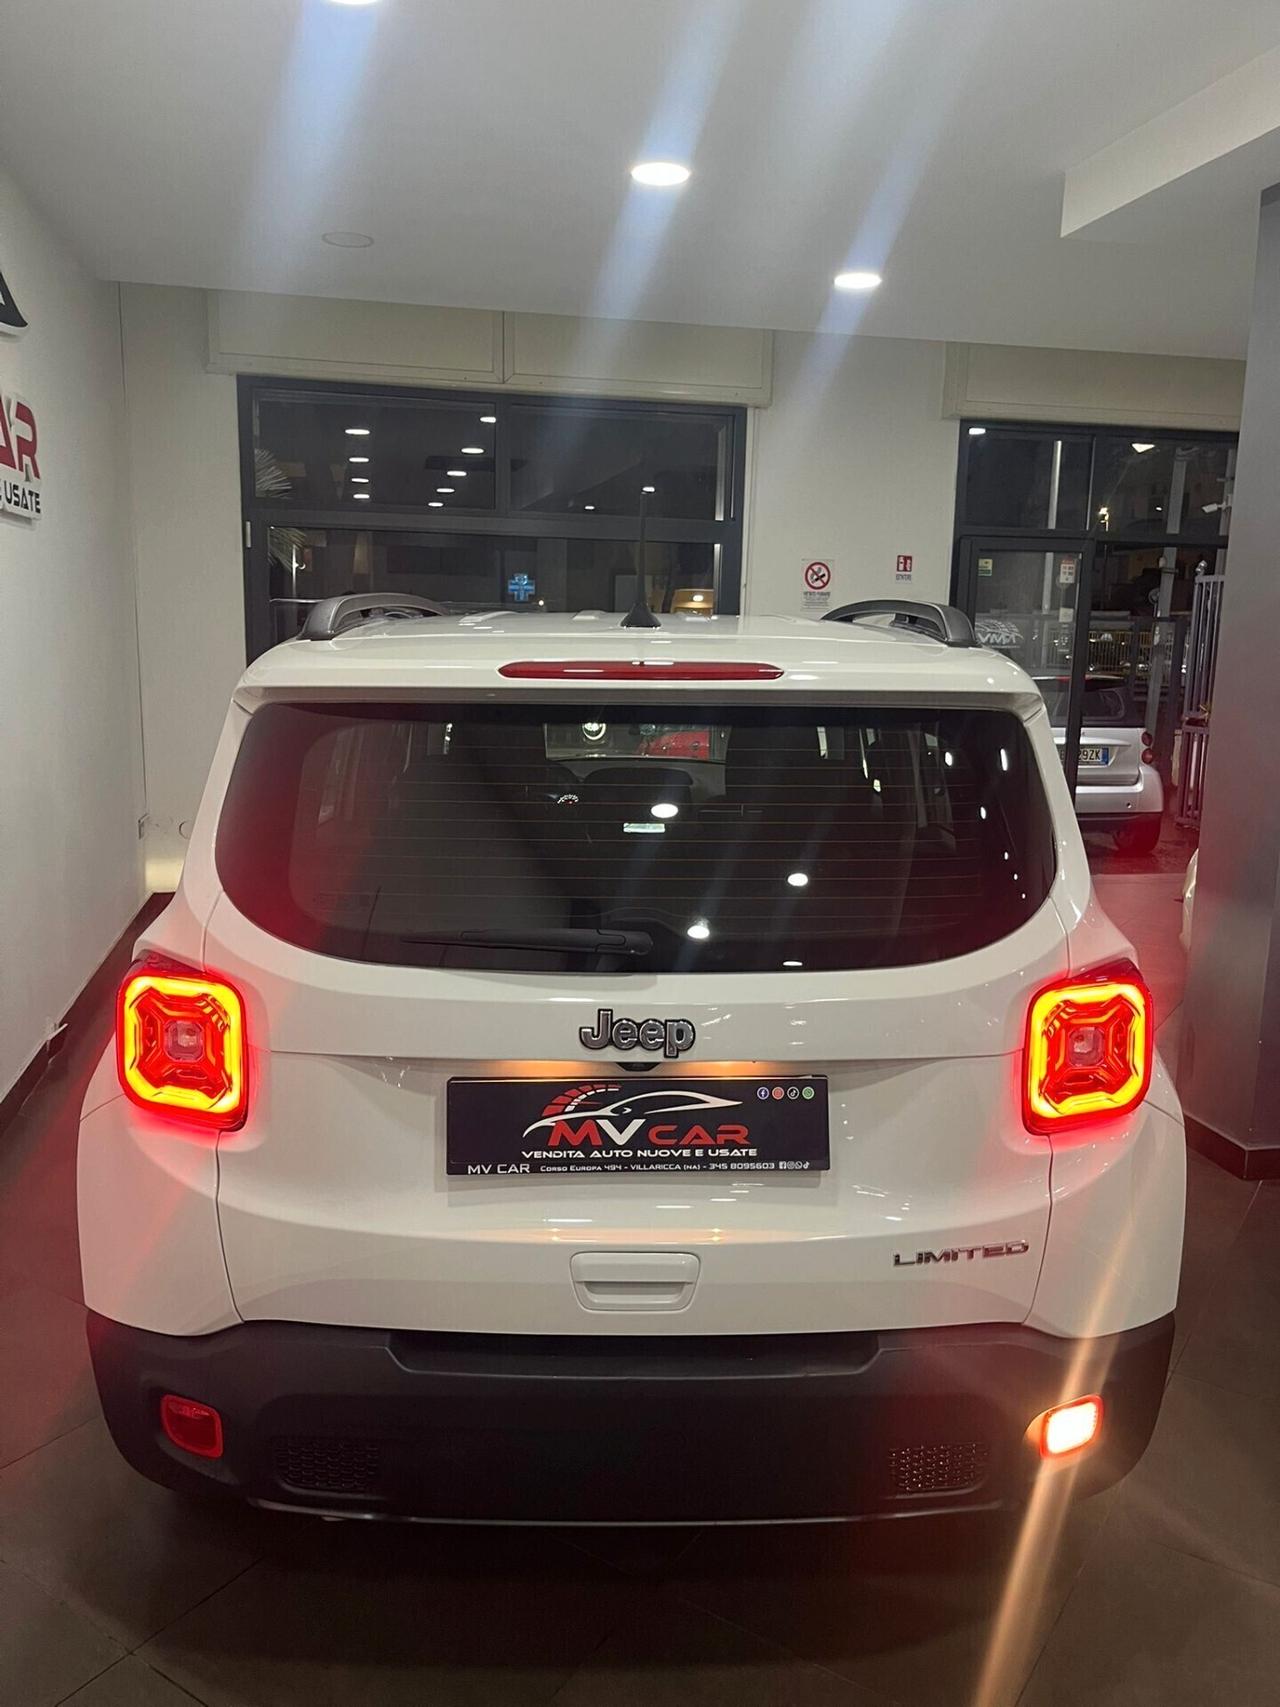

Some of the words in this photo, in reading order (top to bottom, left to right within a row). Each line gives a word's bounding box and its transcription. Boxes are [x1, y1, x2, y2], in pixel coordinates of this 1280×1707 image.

[3, 480, 41, 514] USATE
[579, 1008, 696, 1058] Jeep
[547, 1118, 646, 1147] MV
[648, 1124, 751, 1146] CAR
[521, 1150, 585, 1159] VENDITA
[589, 1149, 634, 1159] AUTO
[637, 1149, 691, 1158] NUOVE
[695, 1149, 703, 1157] E
[708, 1148, 758, 1157] USATE
[630, 1163, 681, 1171] VILLARICCA
[709, 1162, 728, 1170] 345
[467, 1164, 492, 1175] MV
[497, 1163, 531, 1174] CAR
[893, 1240, 1030, 1267] LIMITED
